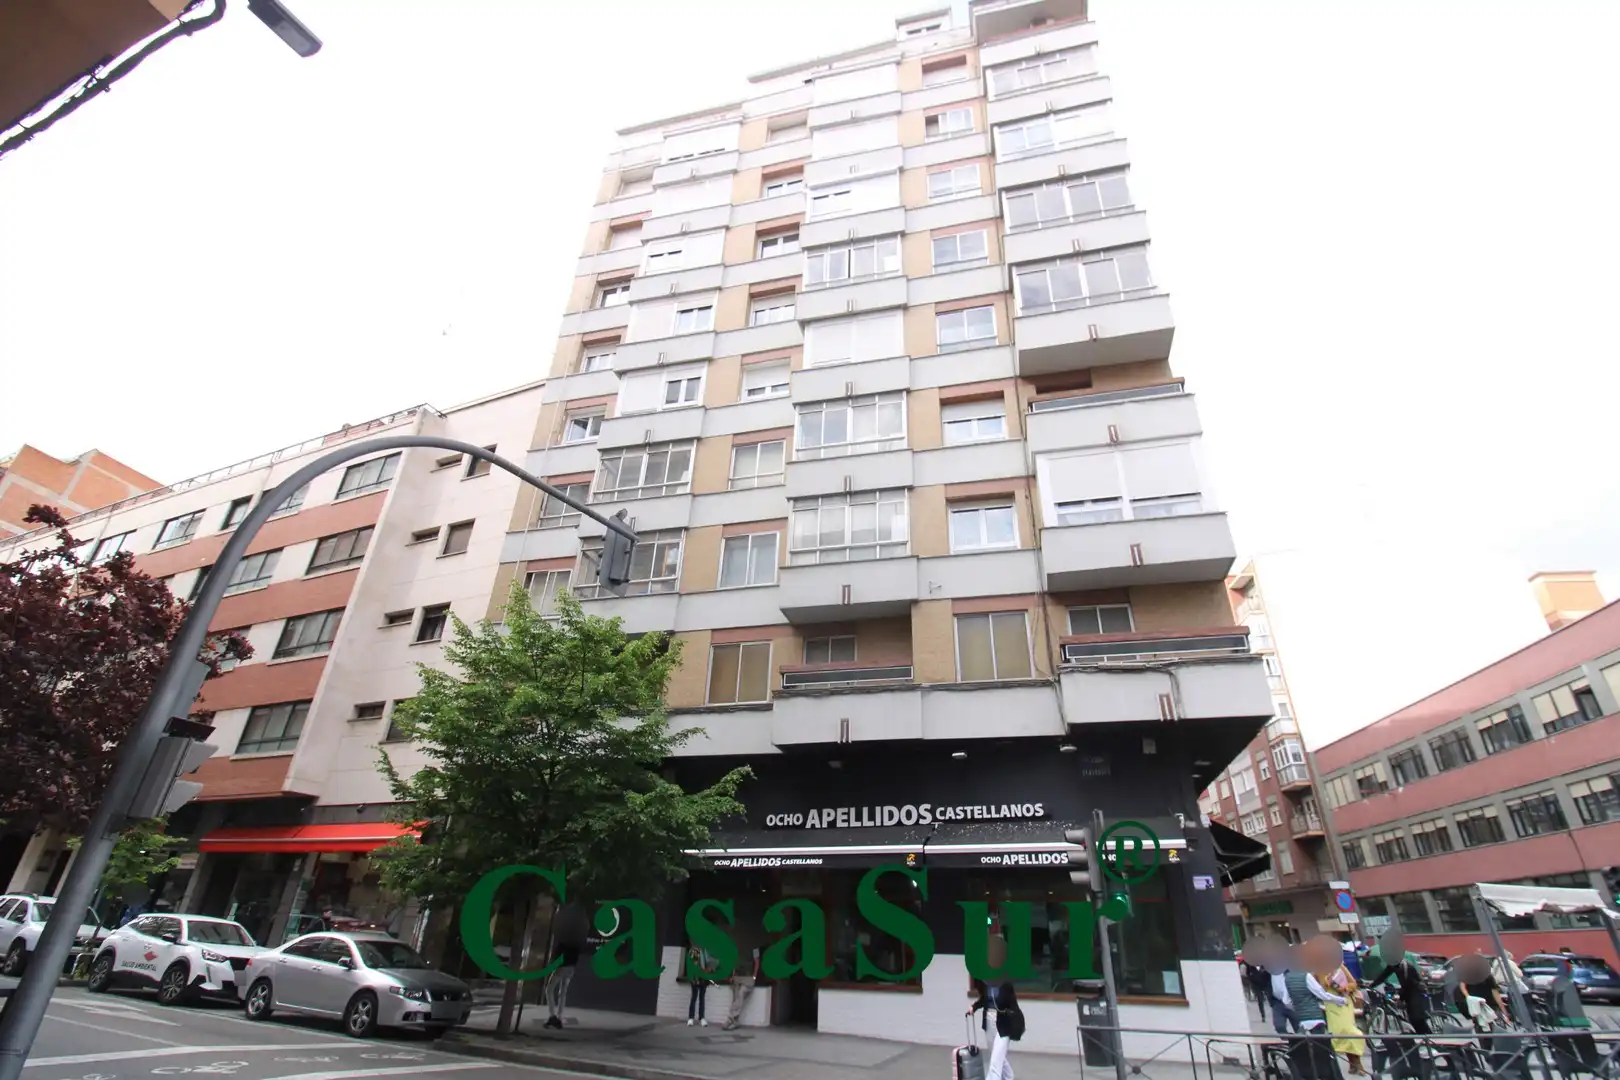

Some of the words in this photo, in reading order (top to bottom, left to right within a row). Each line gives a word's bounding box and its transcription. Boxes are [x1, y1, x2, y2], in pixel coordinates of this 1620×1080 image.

[766, 813, 804, 827] OCHO
[805, 803, 932, 829] APELLIDOS
[935, 803, 1044, 820] CASTELLANOS
[730, 857, 782, 868] APELLIDOS
[980, 856, 1001, 864] OCHO
[1002, 852, 1069, 866] APELLIDOS
